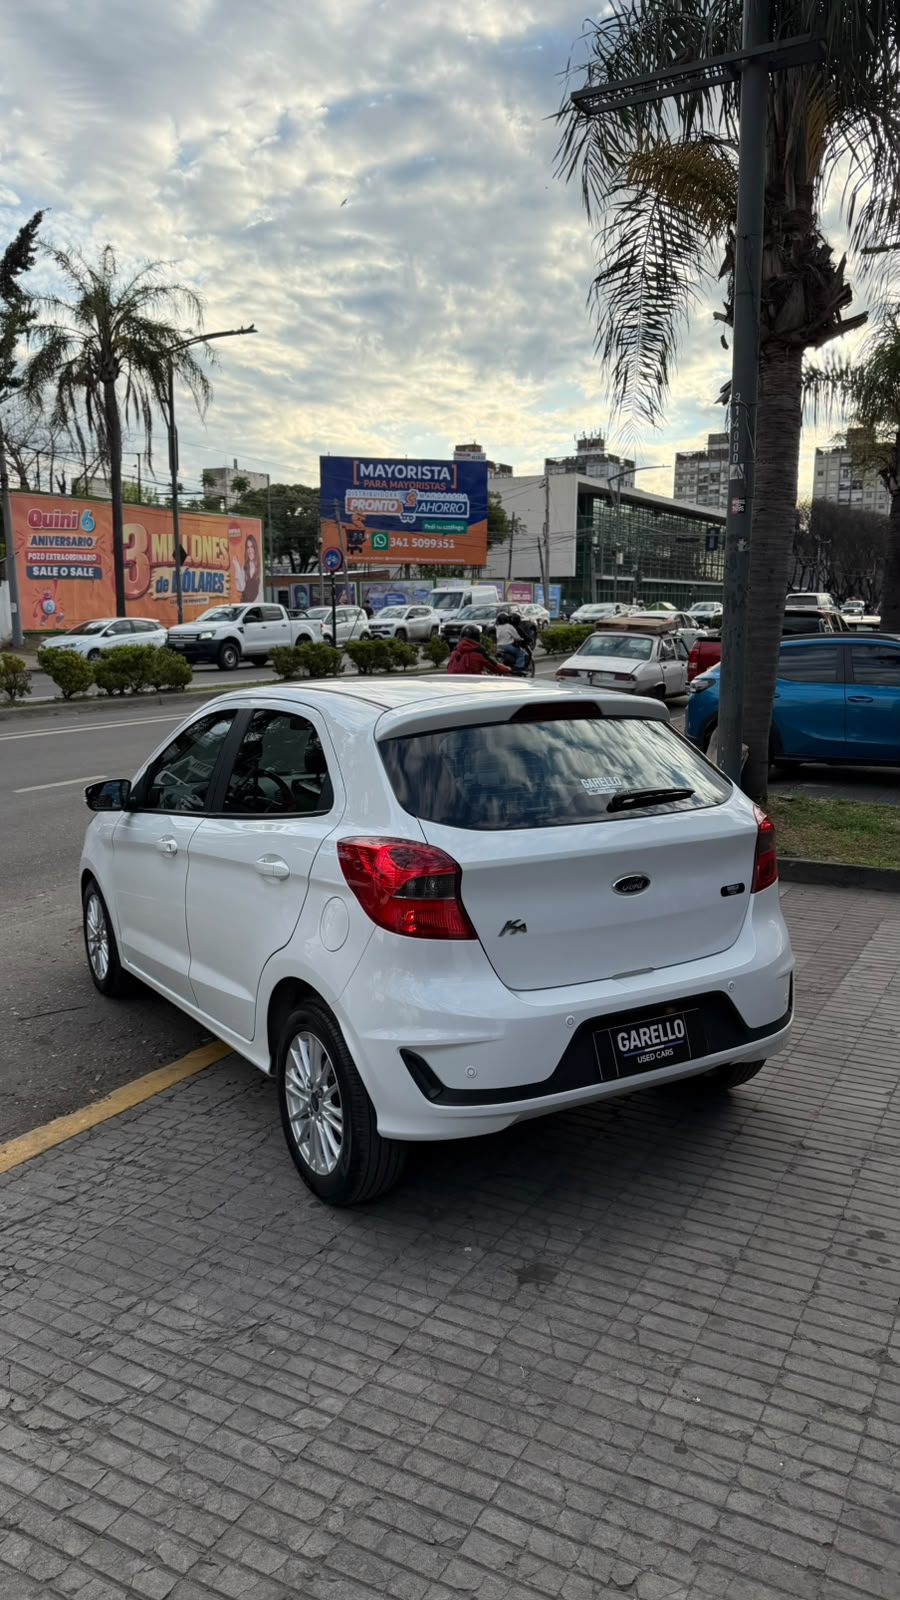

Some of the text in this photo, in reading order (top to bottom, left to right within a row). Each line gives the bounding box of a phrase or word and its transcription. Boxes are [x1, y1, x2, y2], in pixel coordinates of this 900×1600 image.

[360, 463, 450, 480] MAYORISTA
[363, 480, 446, 490] PARA MAYORISTAS
[351, 499, 465, 513] PRONTO AHORRO
[27, 509, 95, 532] Quini 6
[31, 535, 93, 547] ANIVERSARIO
[390, 538, 408, 547] 341
[28, 552, 45, 560] POZO
[152, 533, 228, 566] MILONES
[121, 522, 151, 598] 3
[32, 566, 95, 577] SALE O SALE
[155, 576, 169, 593] de
[580, 776, 622, 789] GARELLO
[617, 1019, 685, 1051] GARELLO
[637, 1048, 674, 1063] USED CARS
